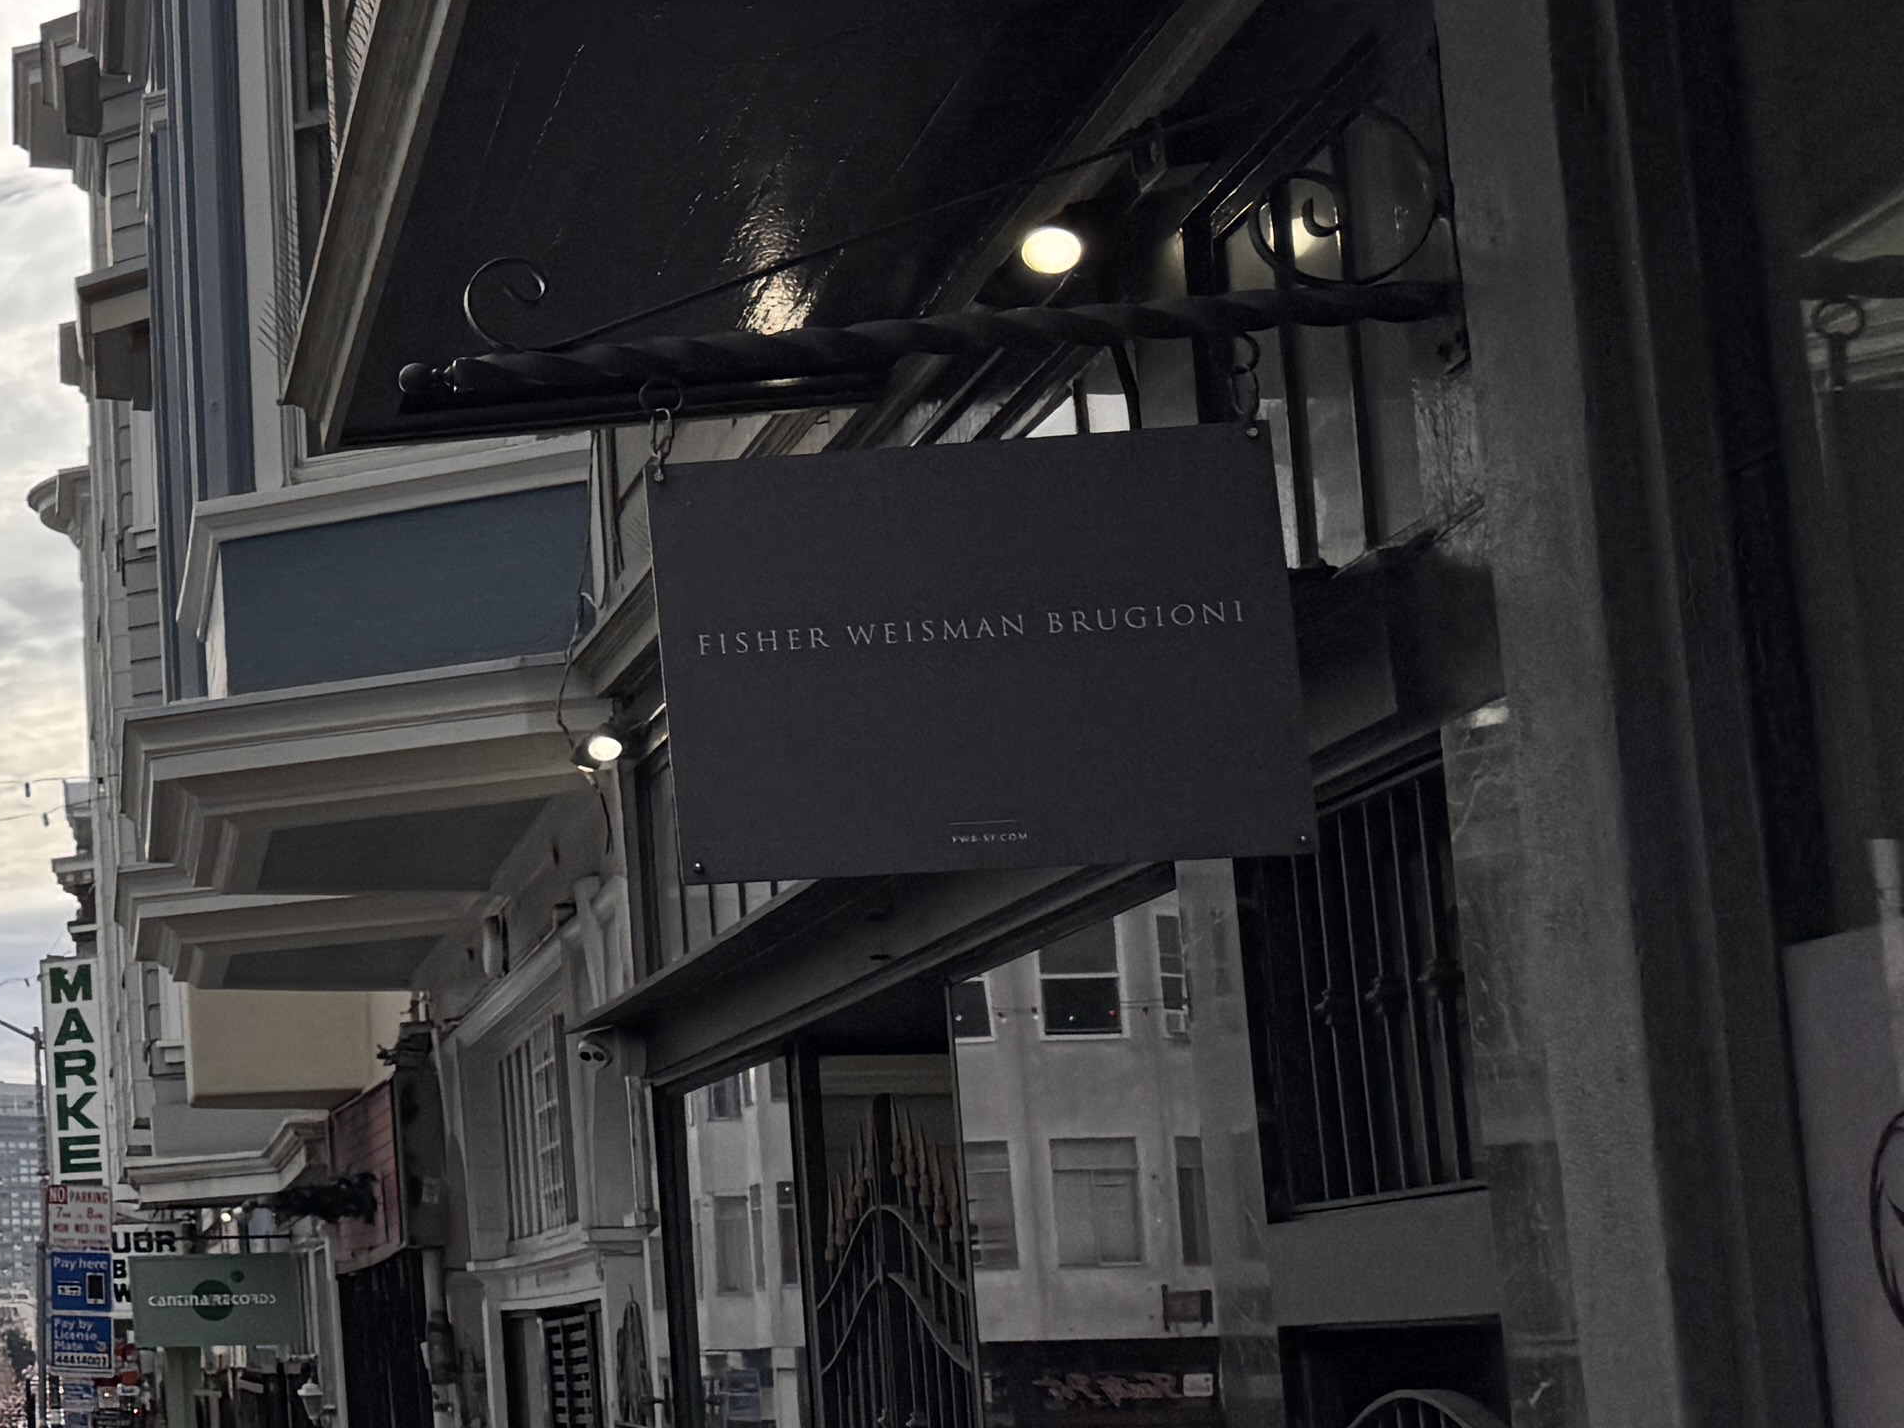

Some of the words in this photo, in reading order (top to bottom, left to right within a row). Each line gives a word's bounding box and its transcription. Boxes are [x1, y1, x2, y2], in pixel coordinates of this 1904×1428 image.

[698, 628, 831, 657] FISHER
[846, 613, 1025, 646] WEISMAN
[1047, 600, 1245, 634] BRUGIONI
[48, 963, 104, 1185] MARKE
[49, 1186, 66, 1203] NO
[69, 1190, 109, 1204] PARKING
[111, 1230, 177, 1253] UOR
[53, 1257, 77, 1271] Pay
[78, 1255, 108, 1270] here
[53, 1318, 76, 1331] Pay
[78, 1318, 94, 1332] by
[53, 1329, 98, 1341] License
[53, 1340, 85, 1352] Plate
